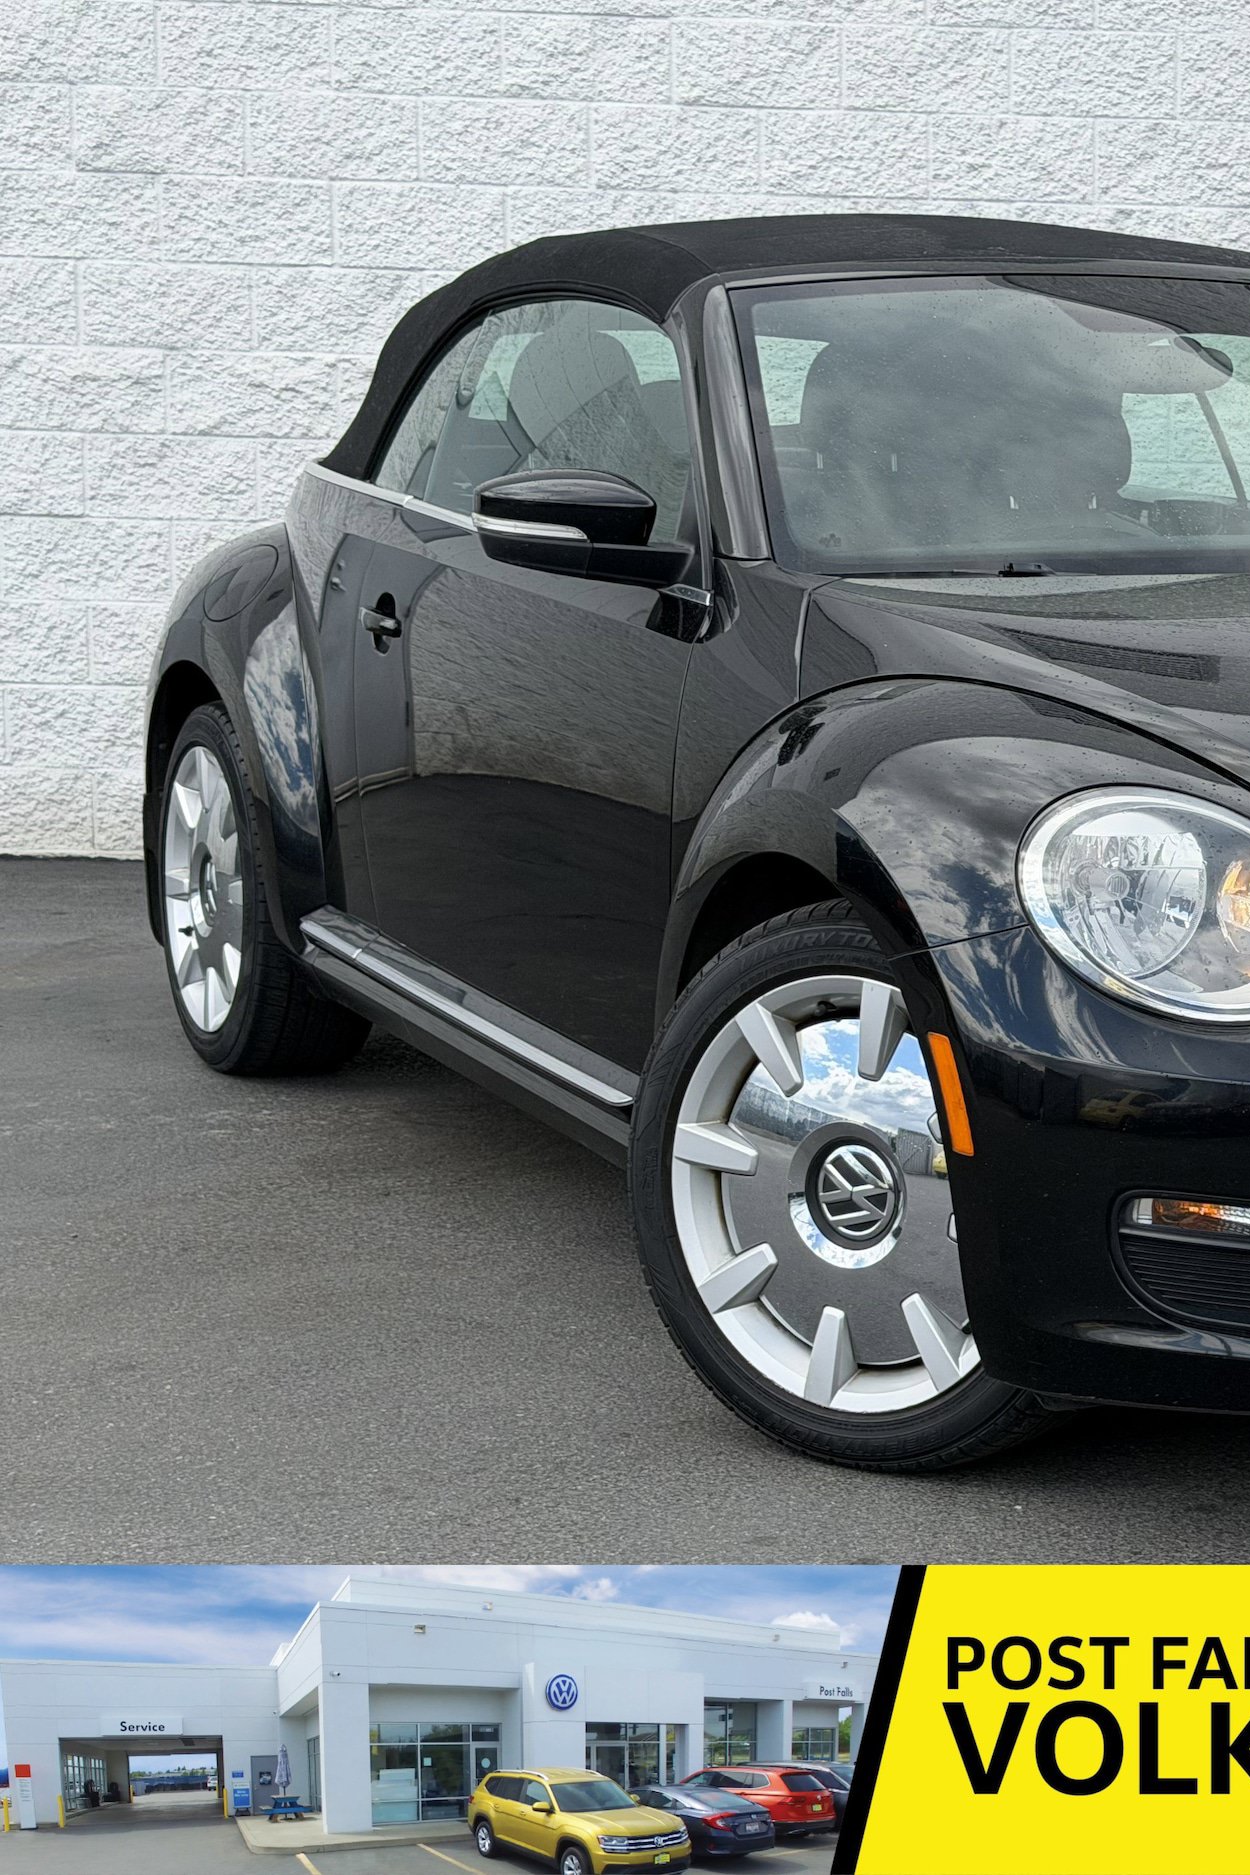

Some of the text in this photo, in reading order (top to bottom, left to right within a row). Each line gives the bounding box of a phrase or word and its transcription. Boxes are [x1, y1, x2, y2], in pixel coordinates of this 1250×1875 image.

[819, 1685, 853, 1698] Post Falls
[120, 1721, 165, 1732] Service
